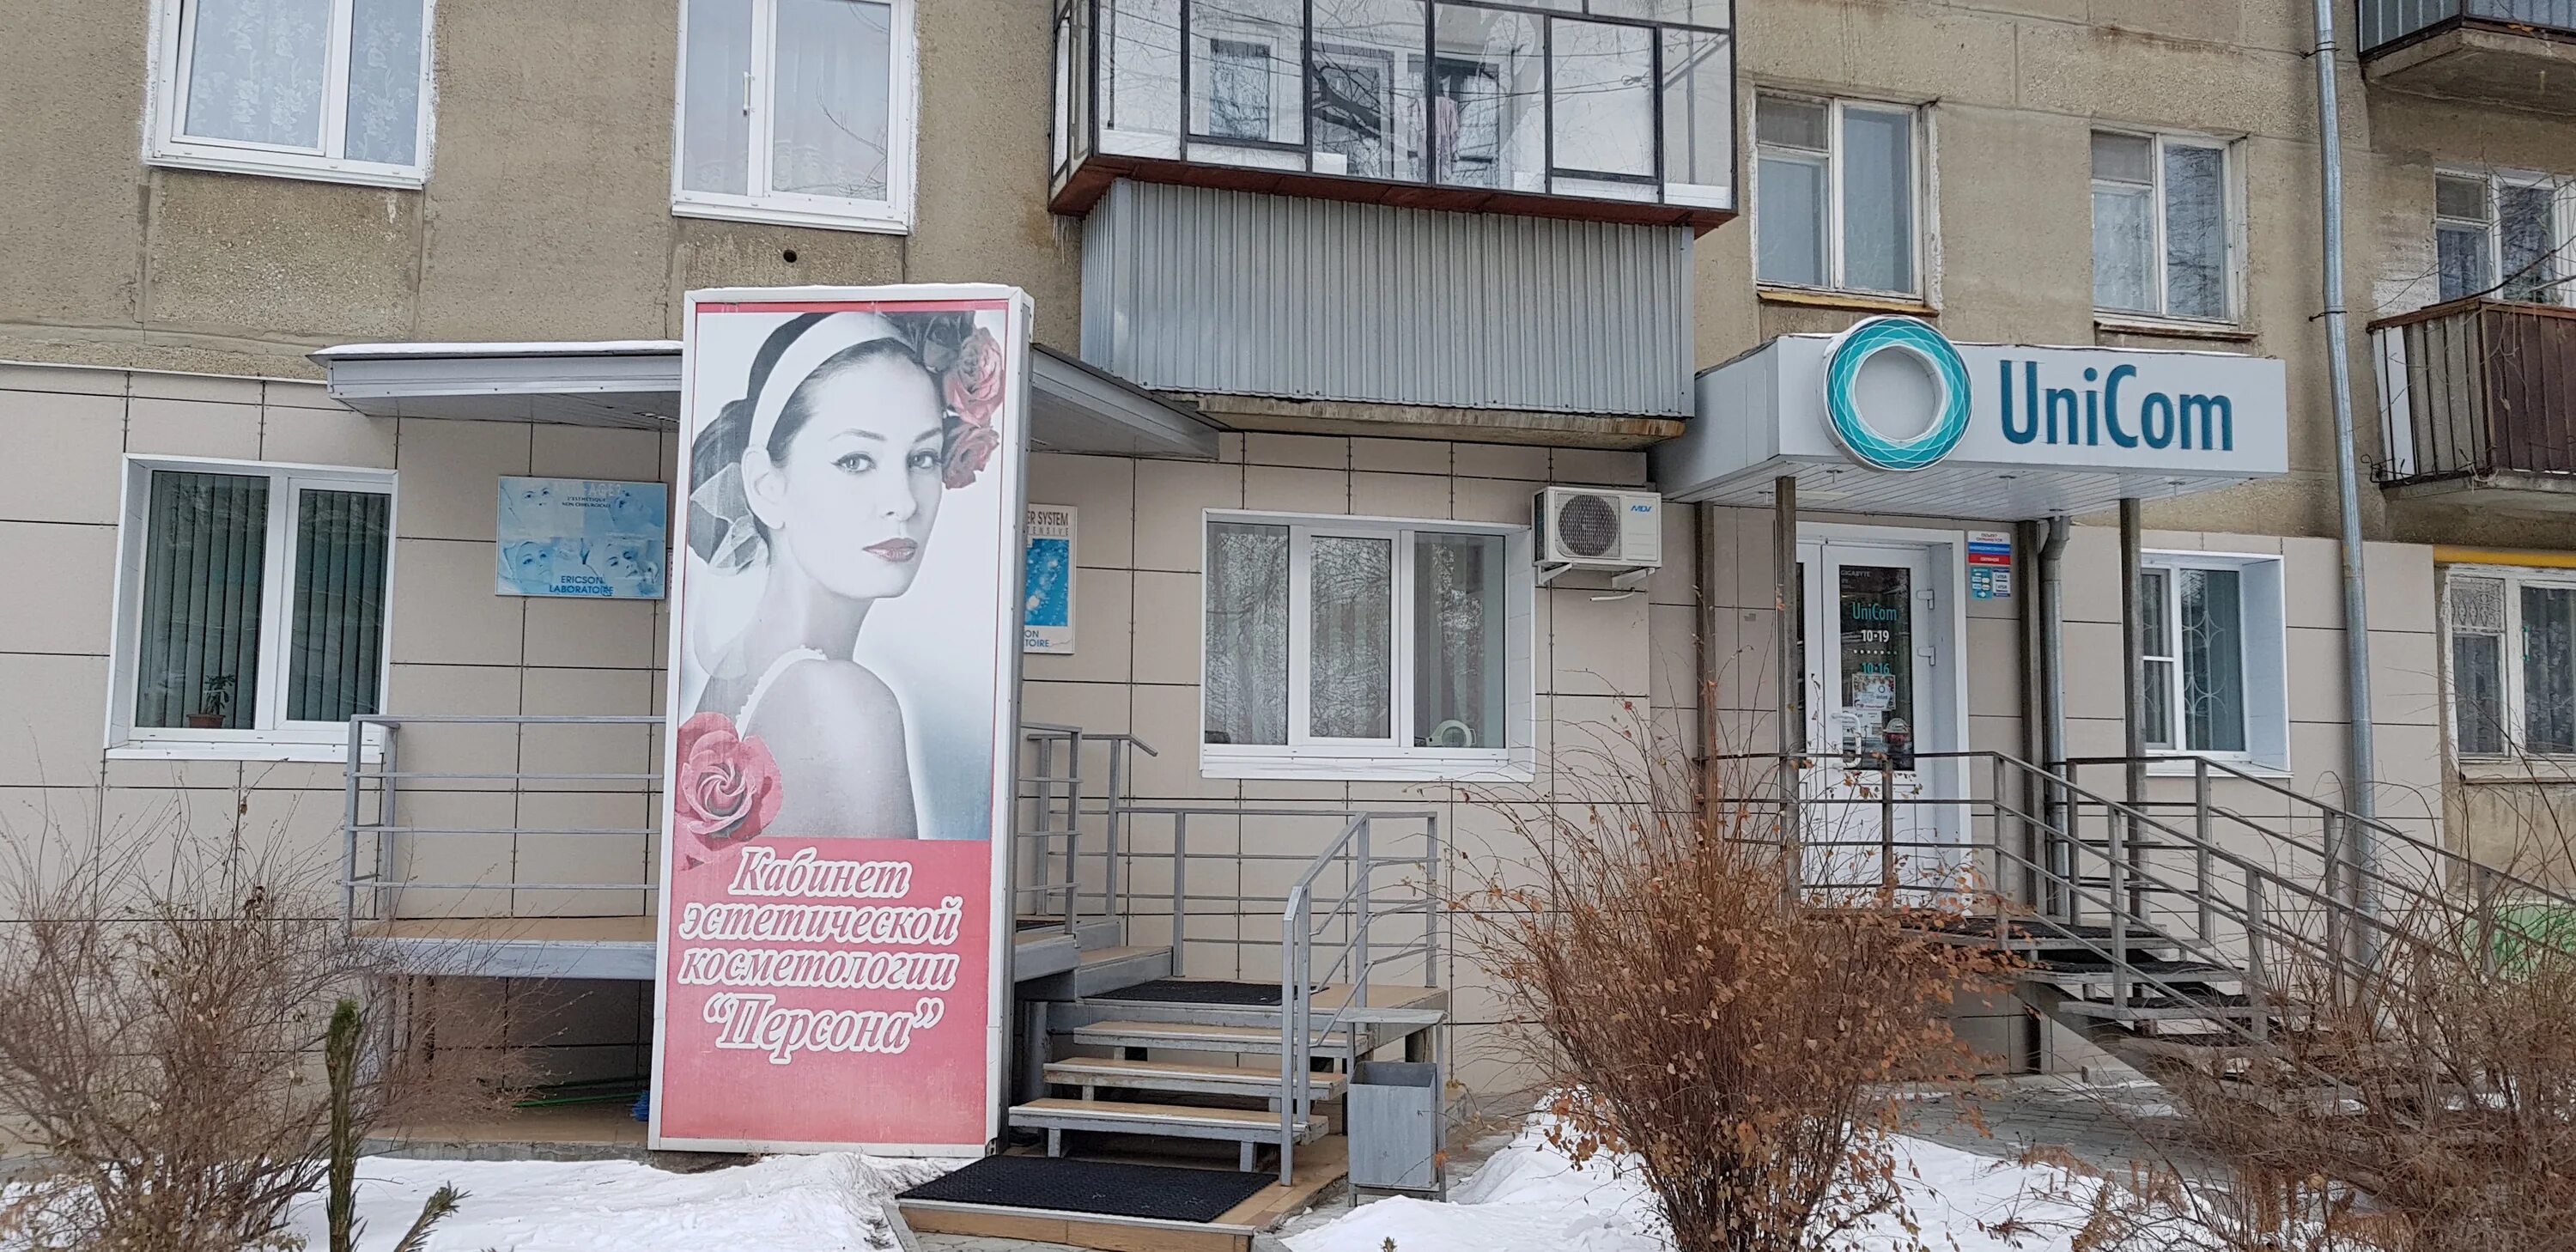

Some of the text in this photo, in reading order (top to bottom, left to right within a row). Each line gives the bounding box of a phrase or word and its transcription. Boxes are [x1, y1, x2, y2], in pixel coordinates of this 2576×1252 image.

[1999, 359, 2233, 452] UniCom
[1037, 511, 1069, 526] SYSTEM
[549, 585, 614, 595] LABORATOIRE
[561, 575, 605, 584] ERICSON
[1852, 602, 1898, 620] UniCom
[728, 846, 913, 898] Кабинет
[679, 896, 963, 945] эстетической
[677, 947, 960, 989] косметологии
